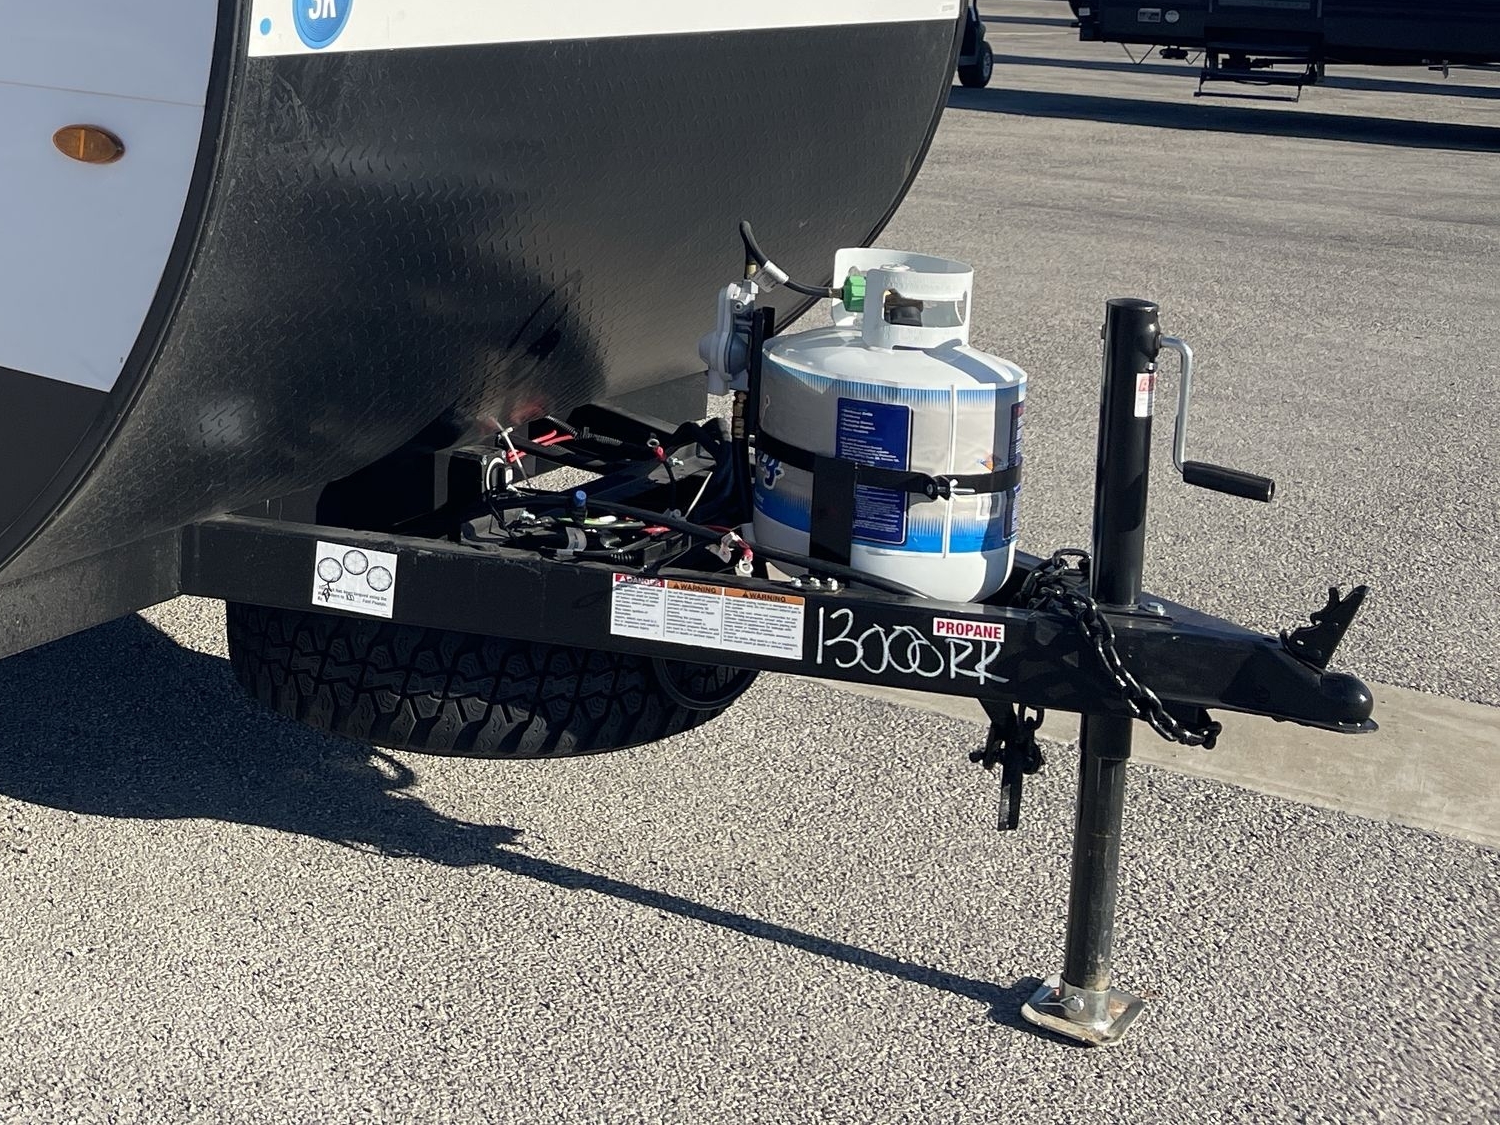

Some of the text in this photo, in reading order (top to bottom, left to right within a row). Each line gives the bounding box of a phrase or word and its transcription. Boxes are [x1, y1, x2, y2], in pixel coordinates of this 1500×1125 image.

[680, 583, 717, 594] WARNING
[749, 592, 787, 603] WARNING
[936, 620, 1002, 640] PROPANE
